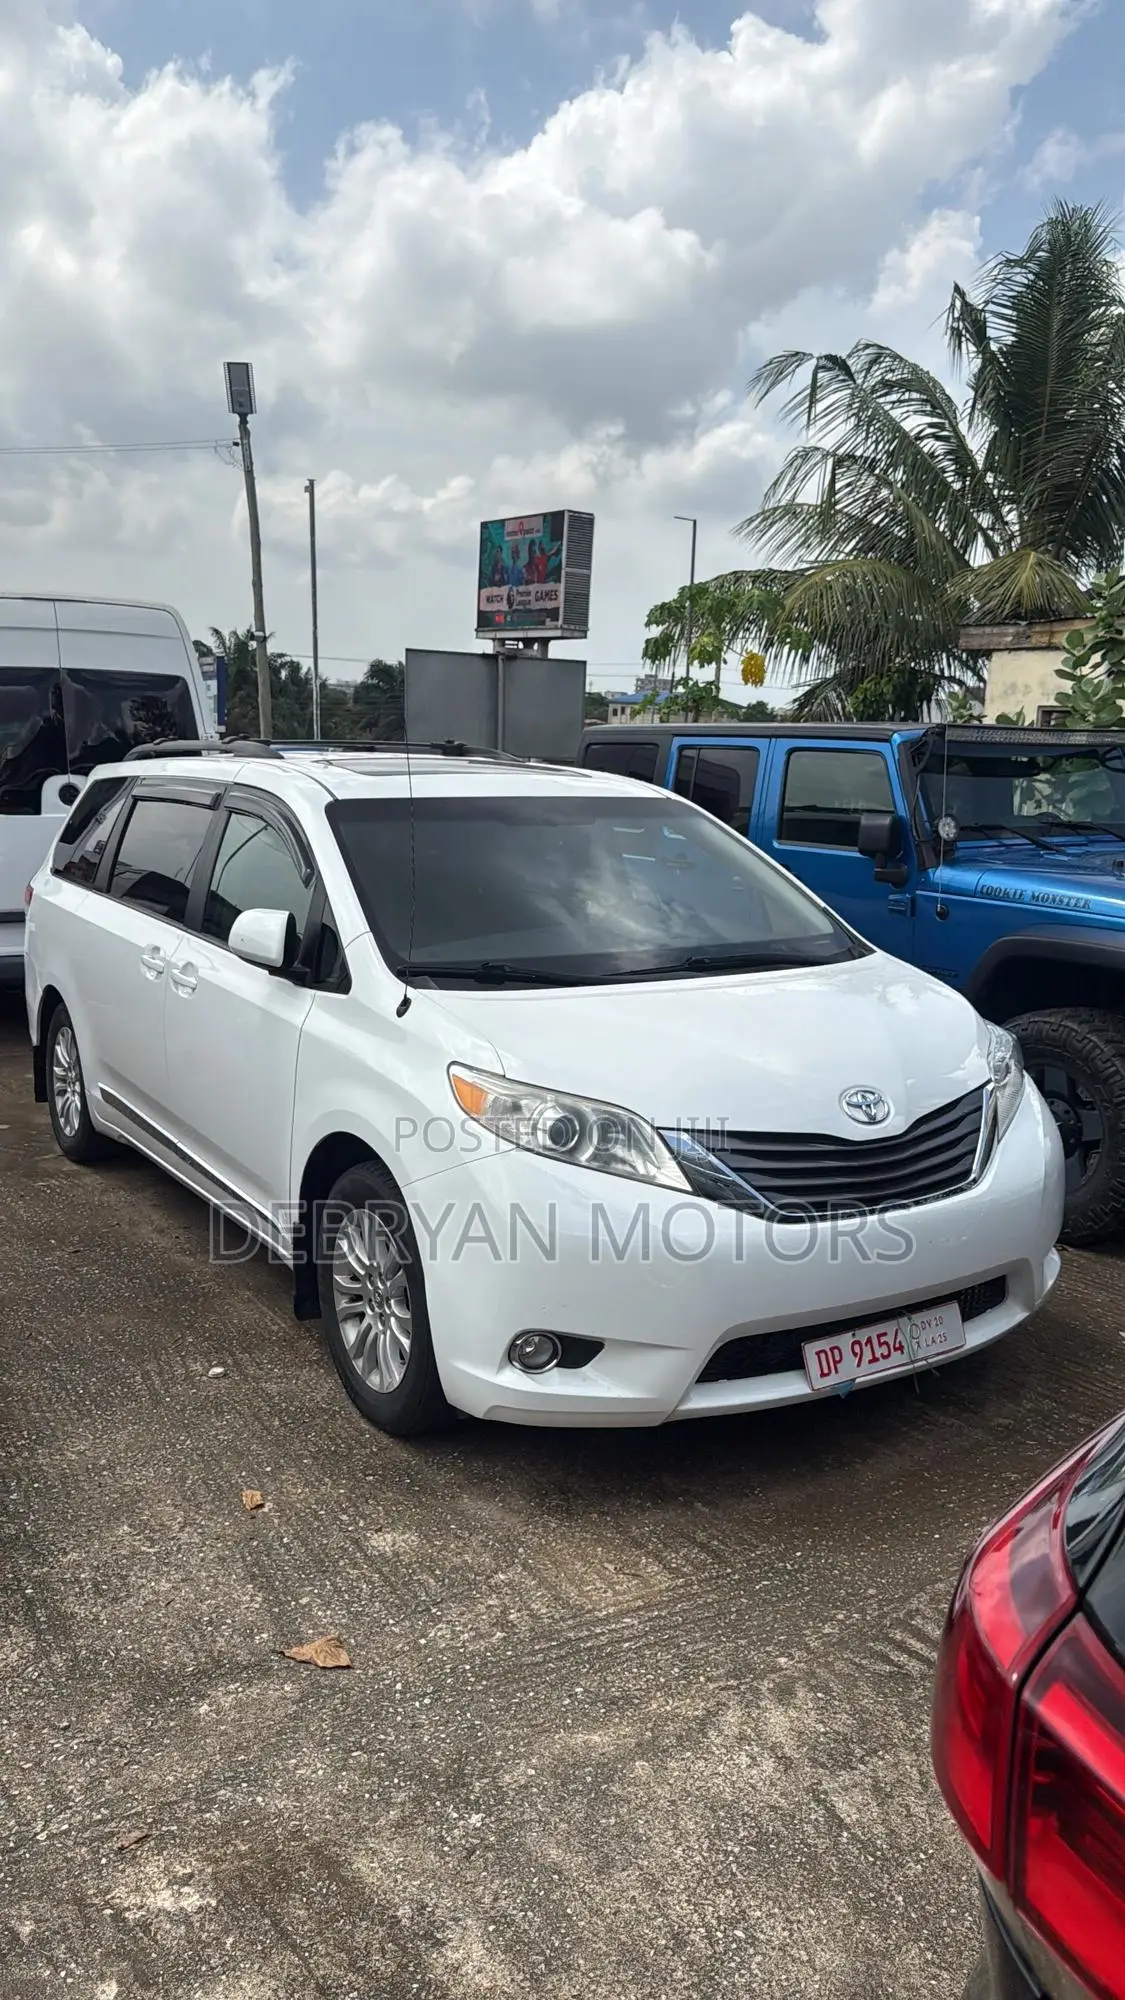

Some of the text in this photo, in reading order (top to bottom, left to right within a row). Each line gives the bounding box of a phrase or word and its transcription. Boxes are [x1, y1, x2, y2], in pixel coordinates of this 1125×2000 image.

[487, 595, 504, 604] WATCH
[535, 589, 559, 602] GAMES
[979, 884, 1093, 910] COOKIE MONSTER
[815, 1328, 905, 1378] DP 9154
